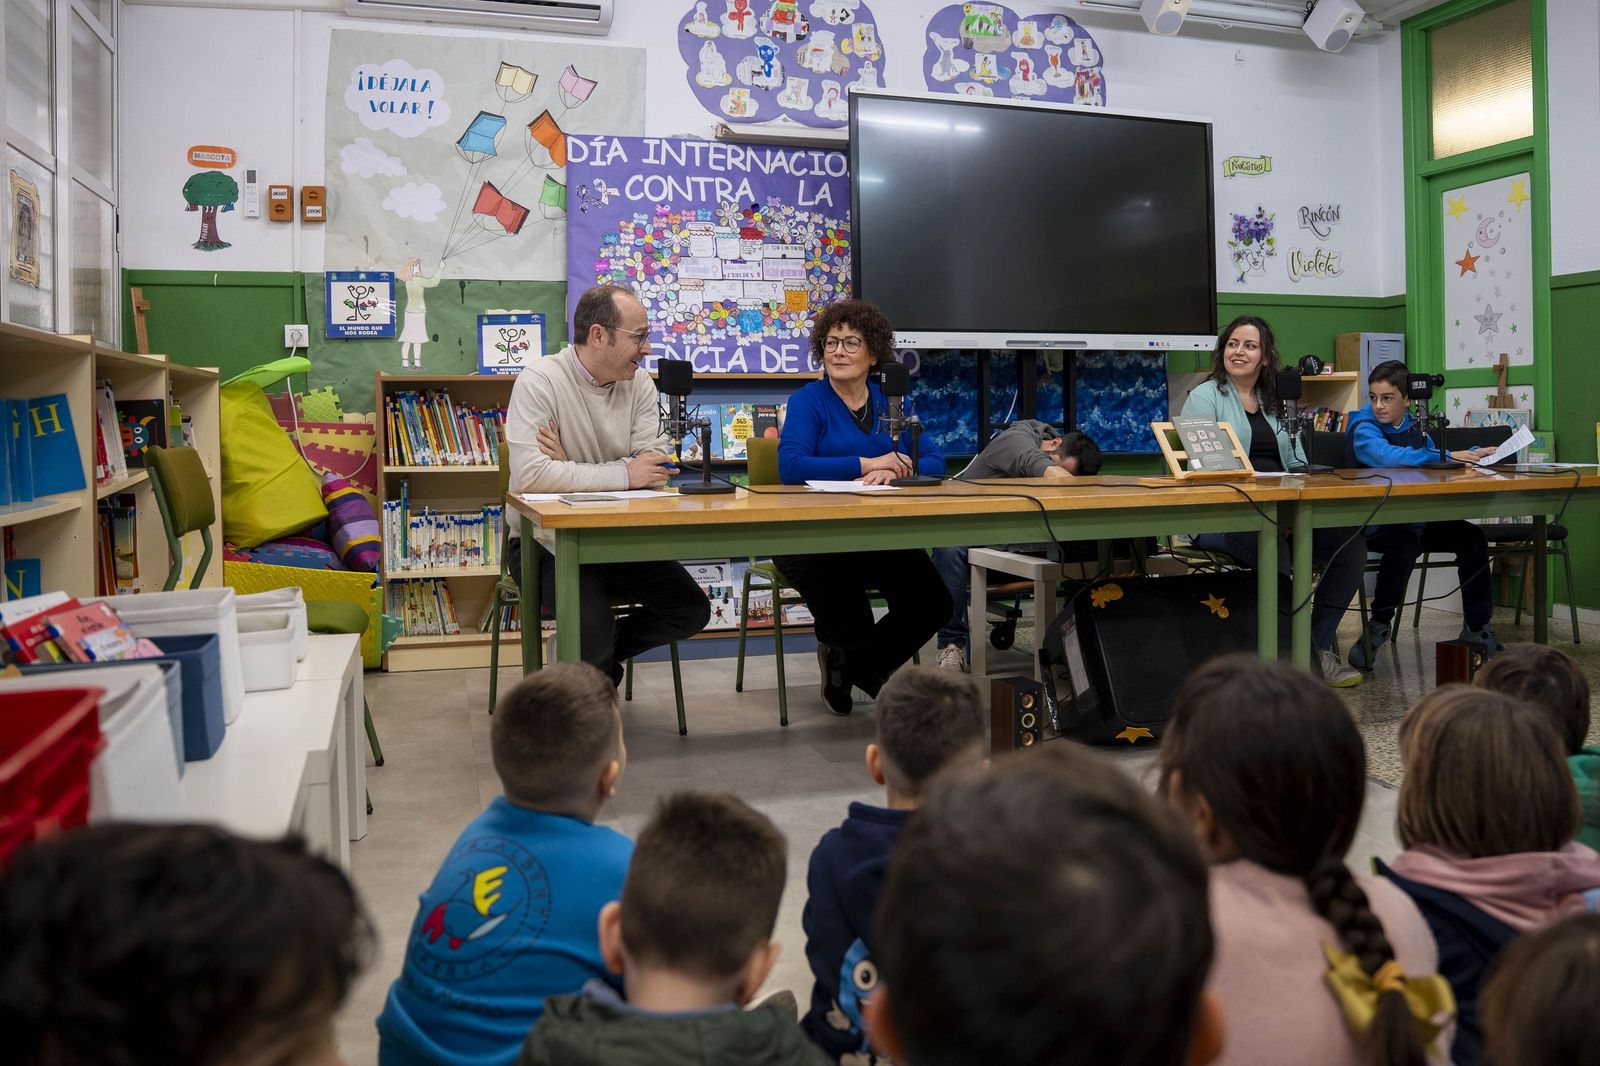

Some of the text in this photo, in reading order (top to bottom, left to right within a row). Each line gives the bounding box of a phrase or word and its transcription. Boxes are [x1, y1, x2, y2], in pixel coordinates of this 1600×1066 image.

[358, 71, 432, 93] ¡DÉJALA
[193, 153, 231, 162] MASCOTA
[566, 135, 849, 178] DÍA INTERNACIO
[624, 175, 833, 207] CONTRA LA
[1291, 248, 1341, 277] Violeta
[761, 344, 800, 374] DE
